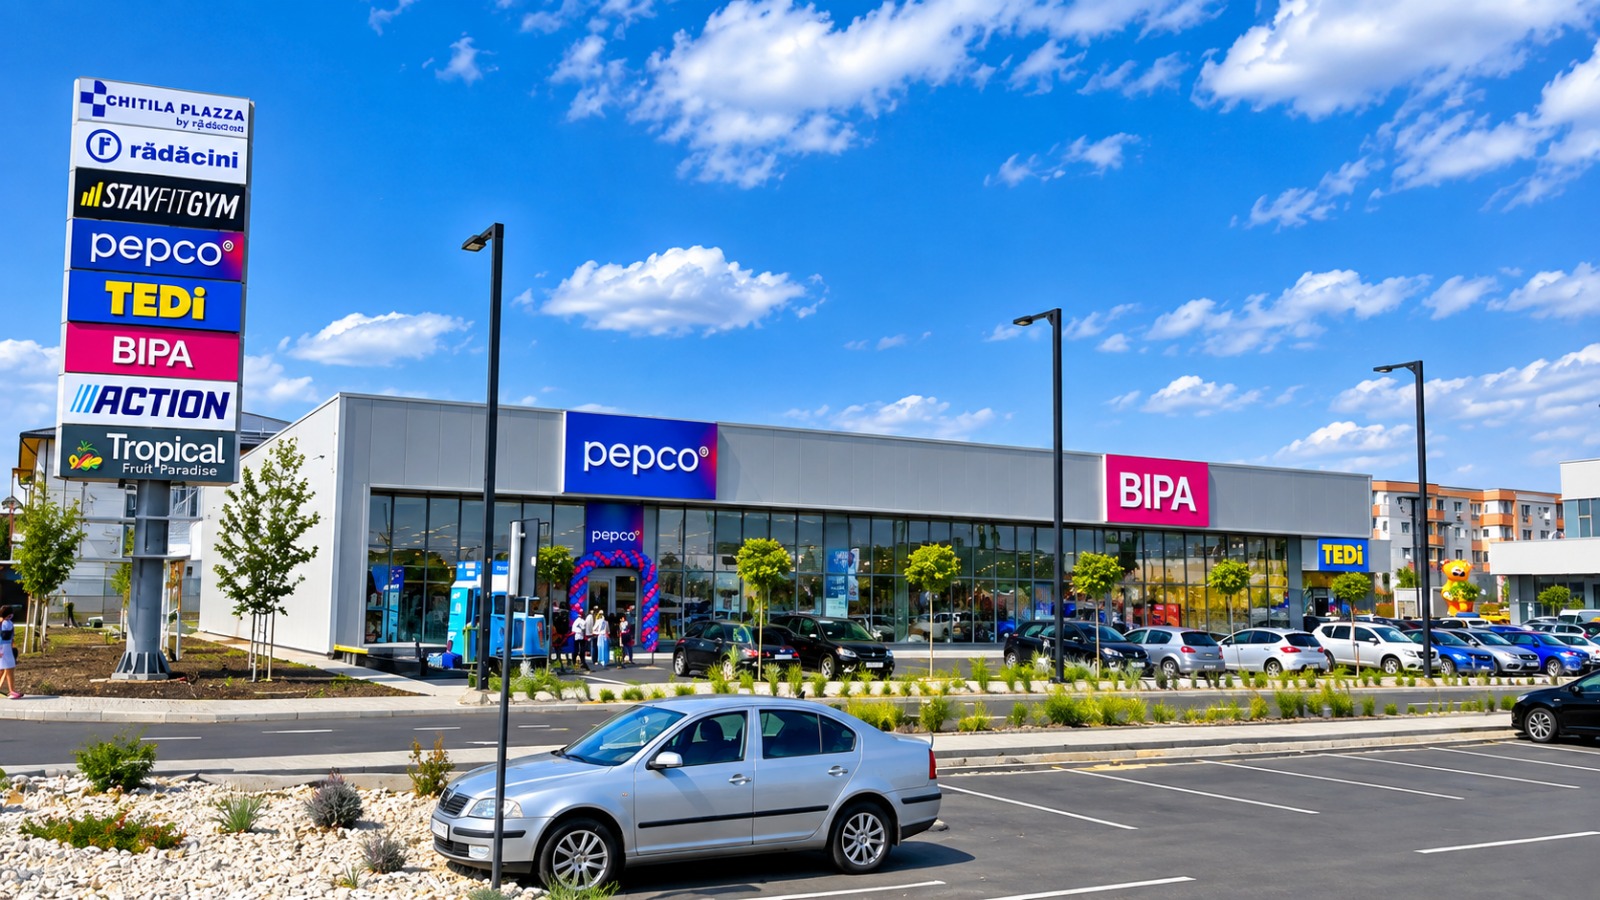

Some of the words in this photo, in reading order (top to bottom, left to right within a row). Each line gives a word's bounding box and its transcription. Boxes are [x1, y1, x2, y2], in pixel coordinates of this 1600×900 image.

[106, 95, 175, 113] CHITILA
[180, 103, 245, 122] PLAZZA
[176, 117, 189, 129] by
[130, 142, 239, 169] rădăcini
[102, 182, 240, 220] STAYFITGYM
[105, 280, 206, 320] TEDi
[112, 335, 193, 368] BIPA
[92, 385, 231, 420] ACTION
[106, 432, 226, 468] Tropical
[122, 463, 153, 475] Fruit
[160, 464, 218, 477] Paradise
[1119, 472, 1197, 512] BIPA
[1322, 544, 1364, 566] TEDi
